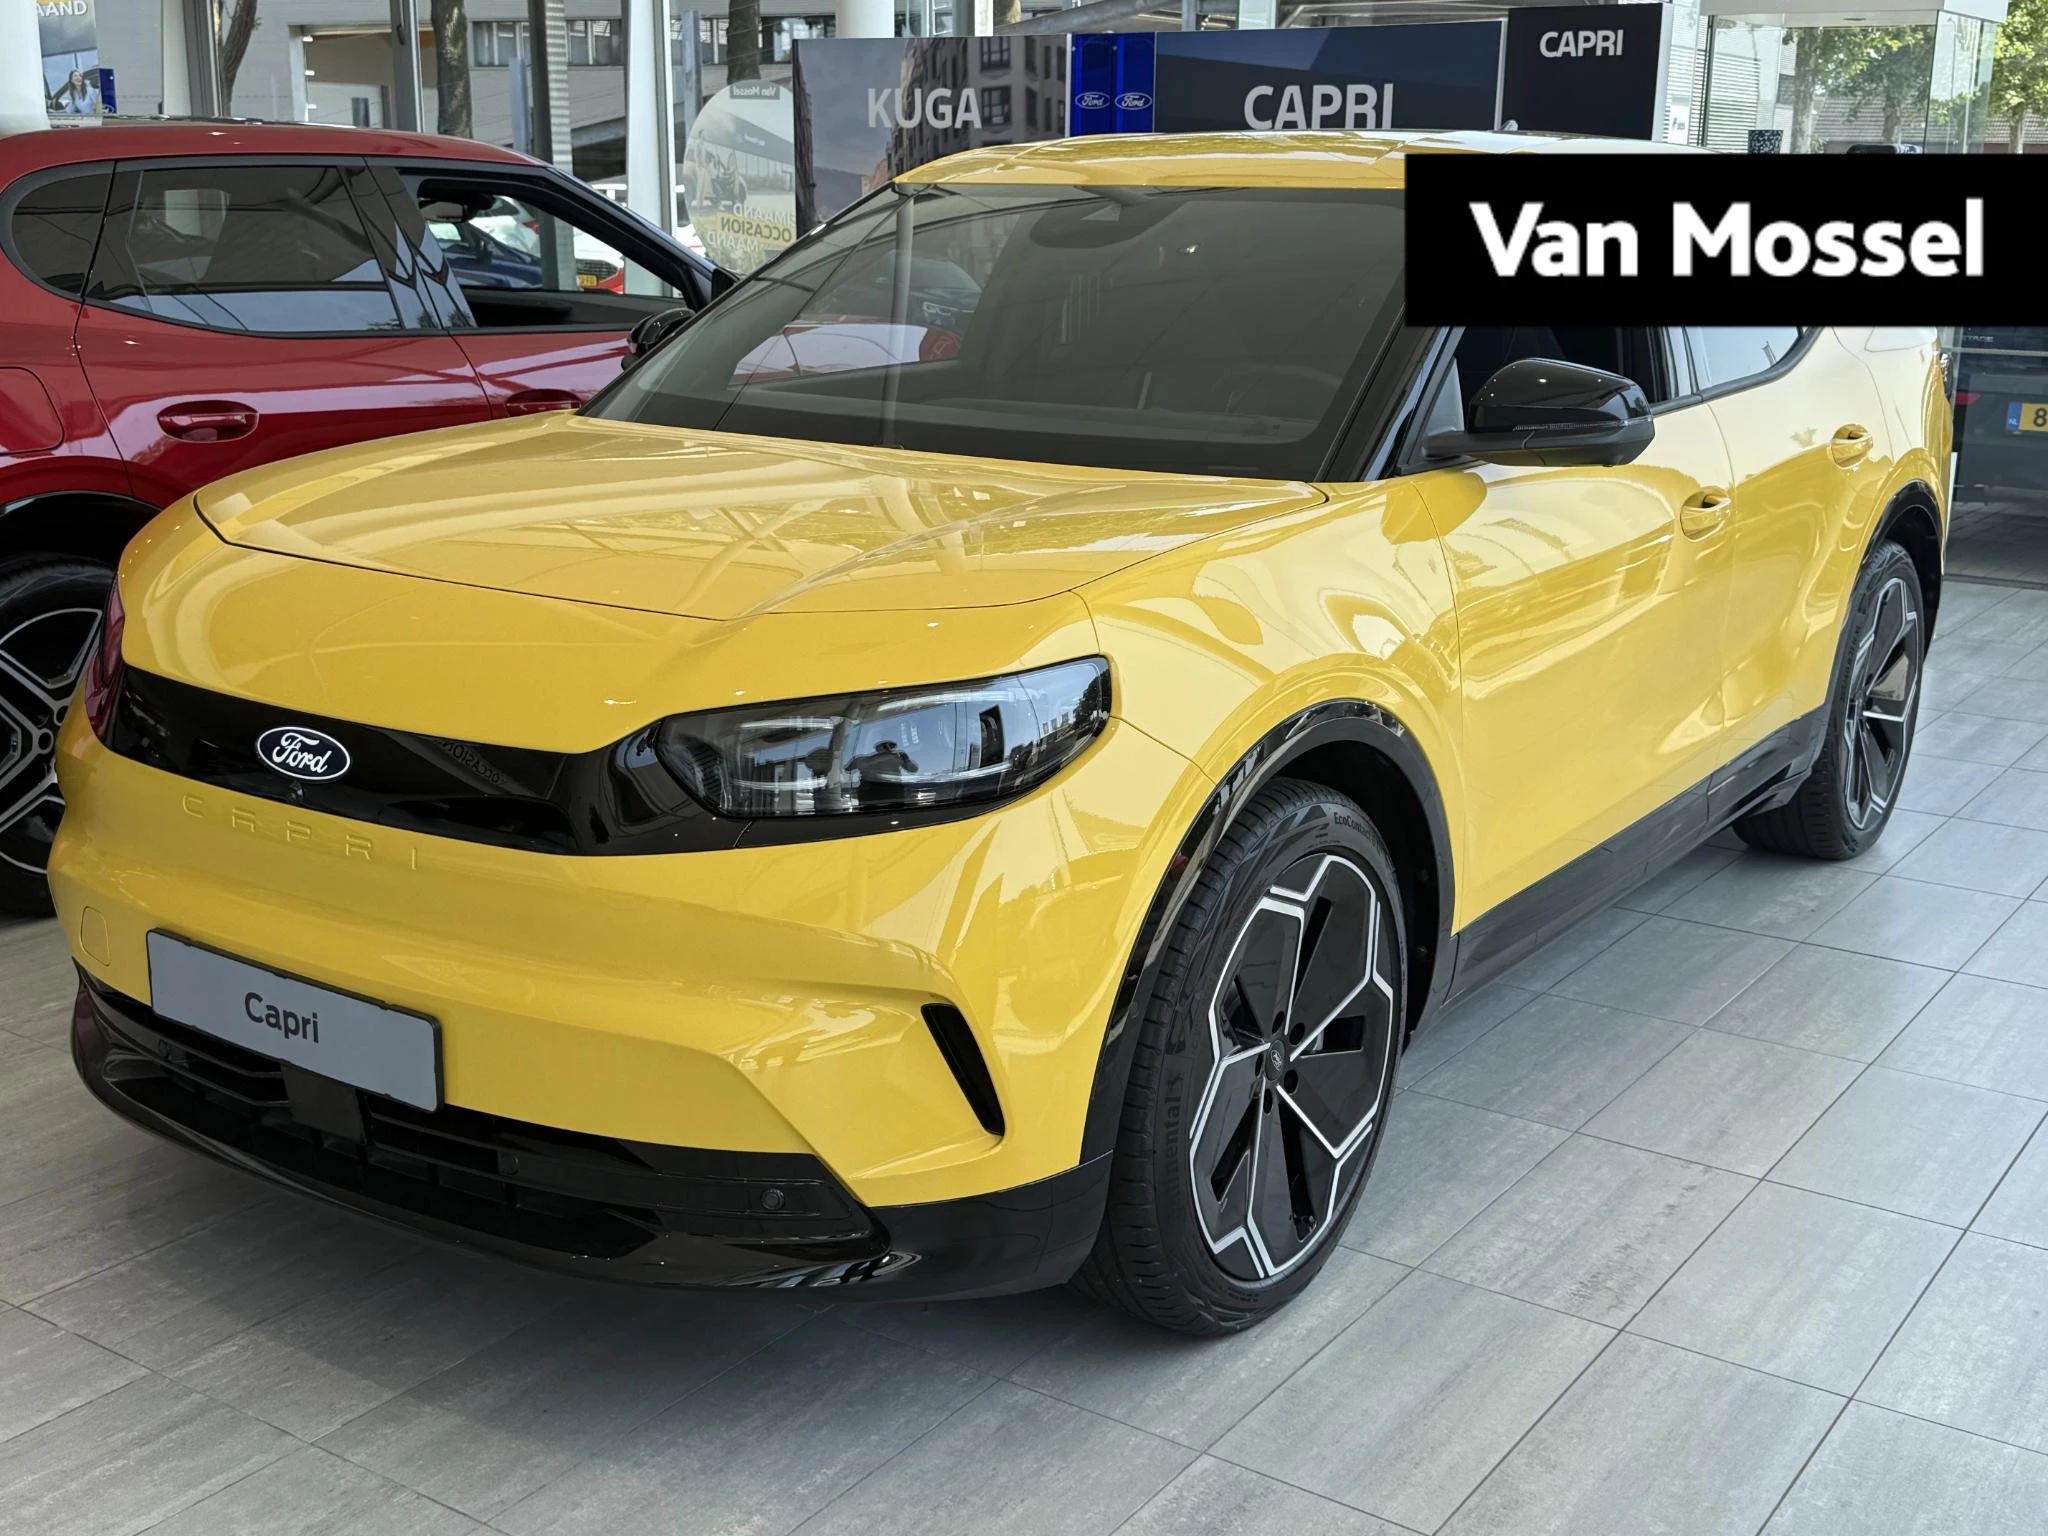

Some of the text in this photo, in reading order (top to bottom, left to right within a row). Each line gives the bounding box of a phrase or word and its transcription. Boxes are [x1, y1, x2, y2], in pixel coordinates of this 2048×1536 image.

[1539, 29, 1624, 58] CAPRI
[868, 88, 982, 129] KUGA
[1080, 93, 1106, 107] Ford
[1120, 94, 1147, 108] Ford
[1244, 83, 1394, 130] CAPRI
[270, 731, 334, 775] Ford
[182, 793, 418, 871] CAPRI
[244, 991, 319, 1044] Capri
